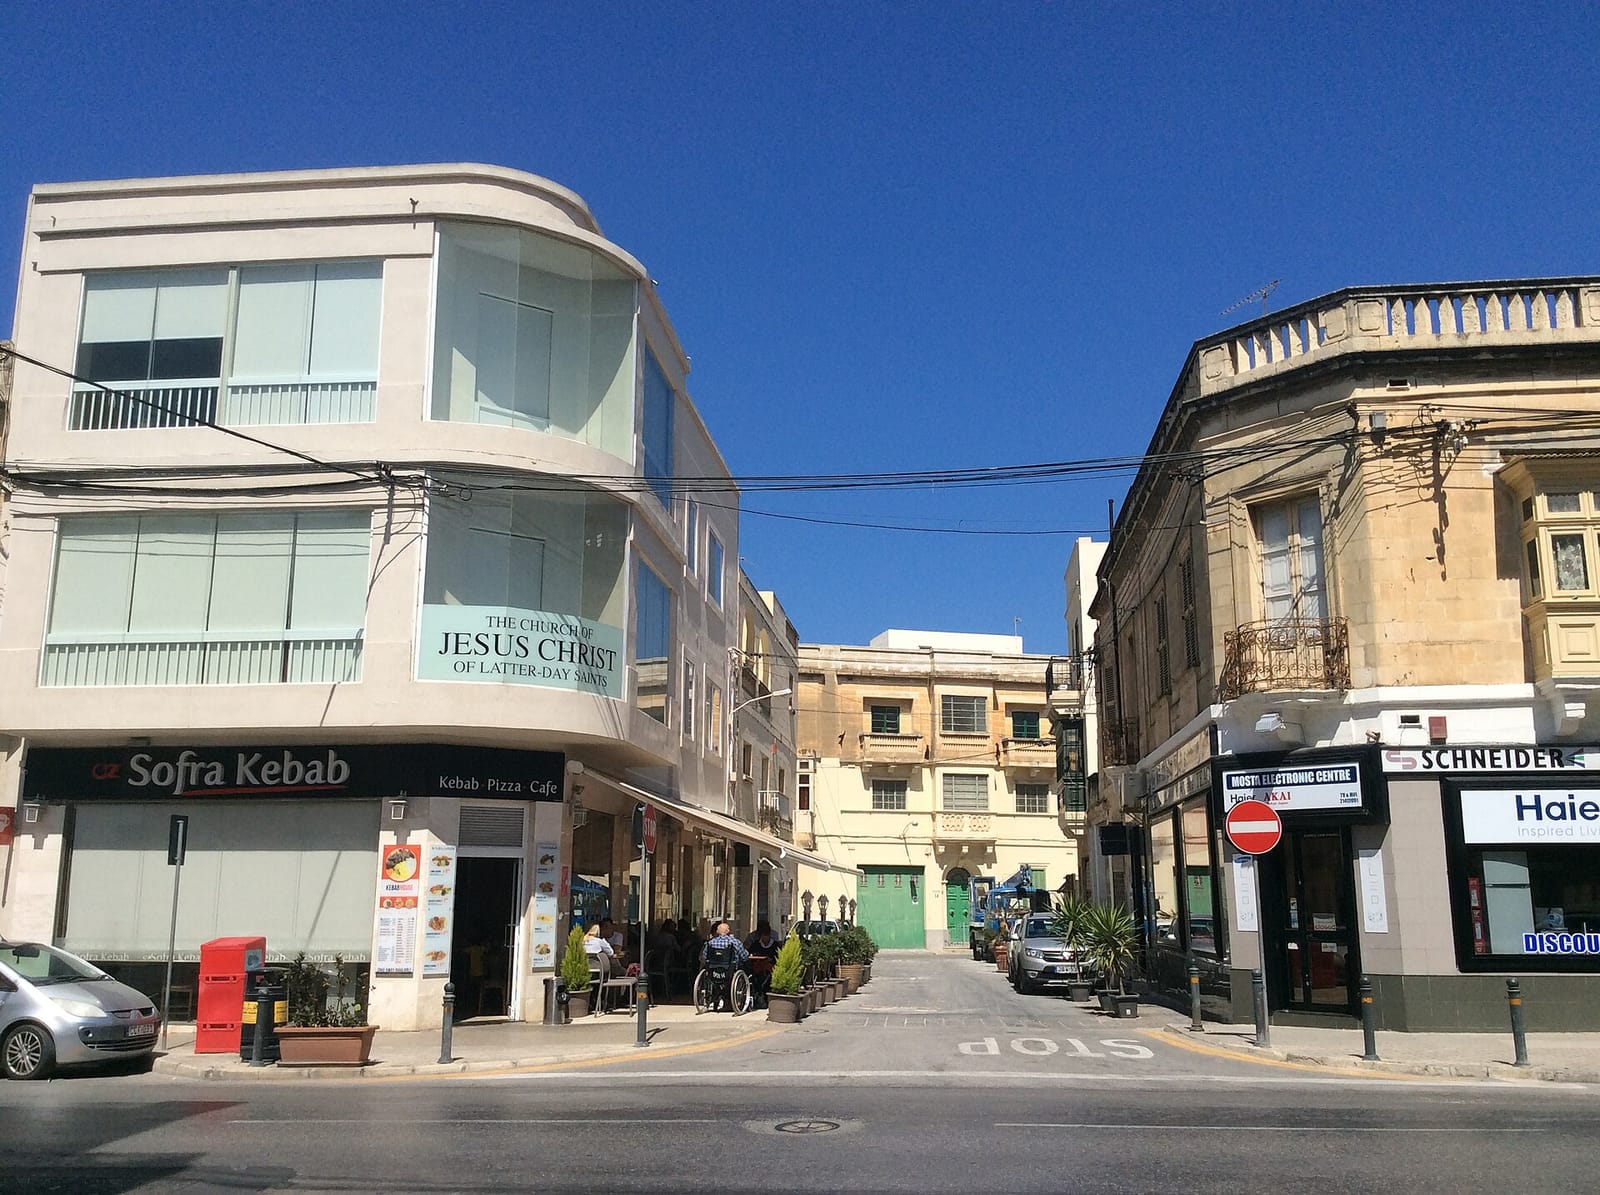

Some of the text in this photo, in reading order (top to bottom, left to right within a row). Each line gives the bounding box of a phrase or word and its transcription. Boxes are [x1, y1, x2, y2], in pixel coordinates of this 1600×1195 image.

[486, 615, 594, 640] THE CHURCH OF
[438, 632, 617, 672] JESUS CHRIST
[453, 661, 608, 687] OF LATTER-DAY SAINTS
[1421, 748, 1565, 770] SCHNEIDER
[128, 750, 225, 795] Sofra
[235, 749, 350, 785] Kebab
[1231, 769, 1352, 788] MOSTA ELECTRONIC CENTRE
[439, 775, 557, 797] Kebab Pizza Cafe
[1263, 791, 1291, 802] AKAI
[644, 817, 657, 837] STOP
[1518, 825, 1574, 839] Inspired
[1523, 932, 1600, 954] DISCOU
[958, 1037, 1154, 1059] STOP
